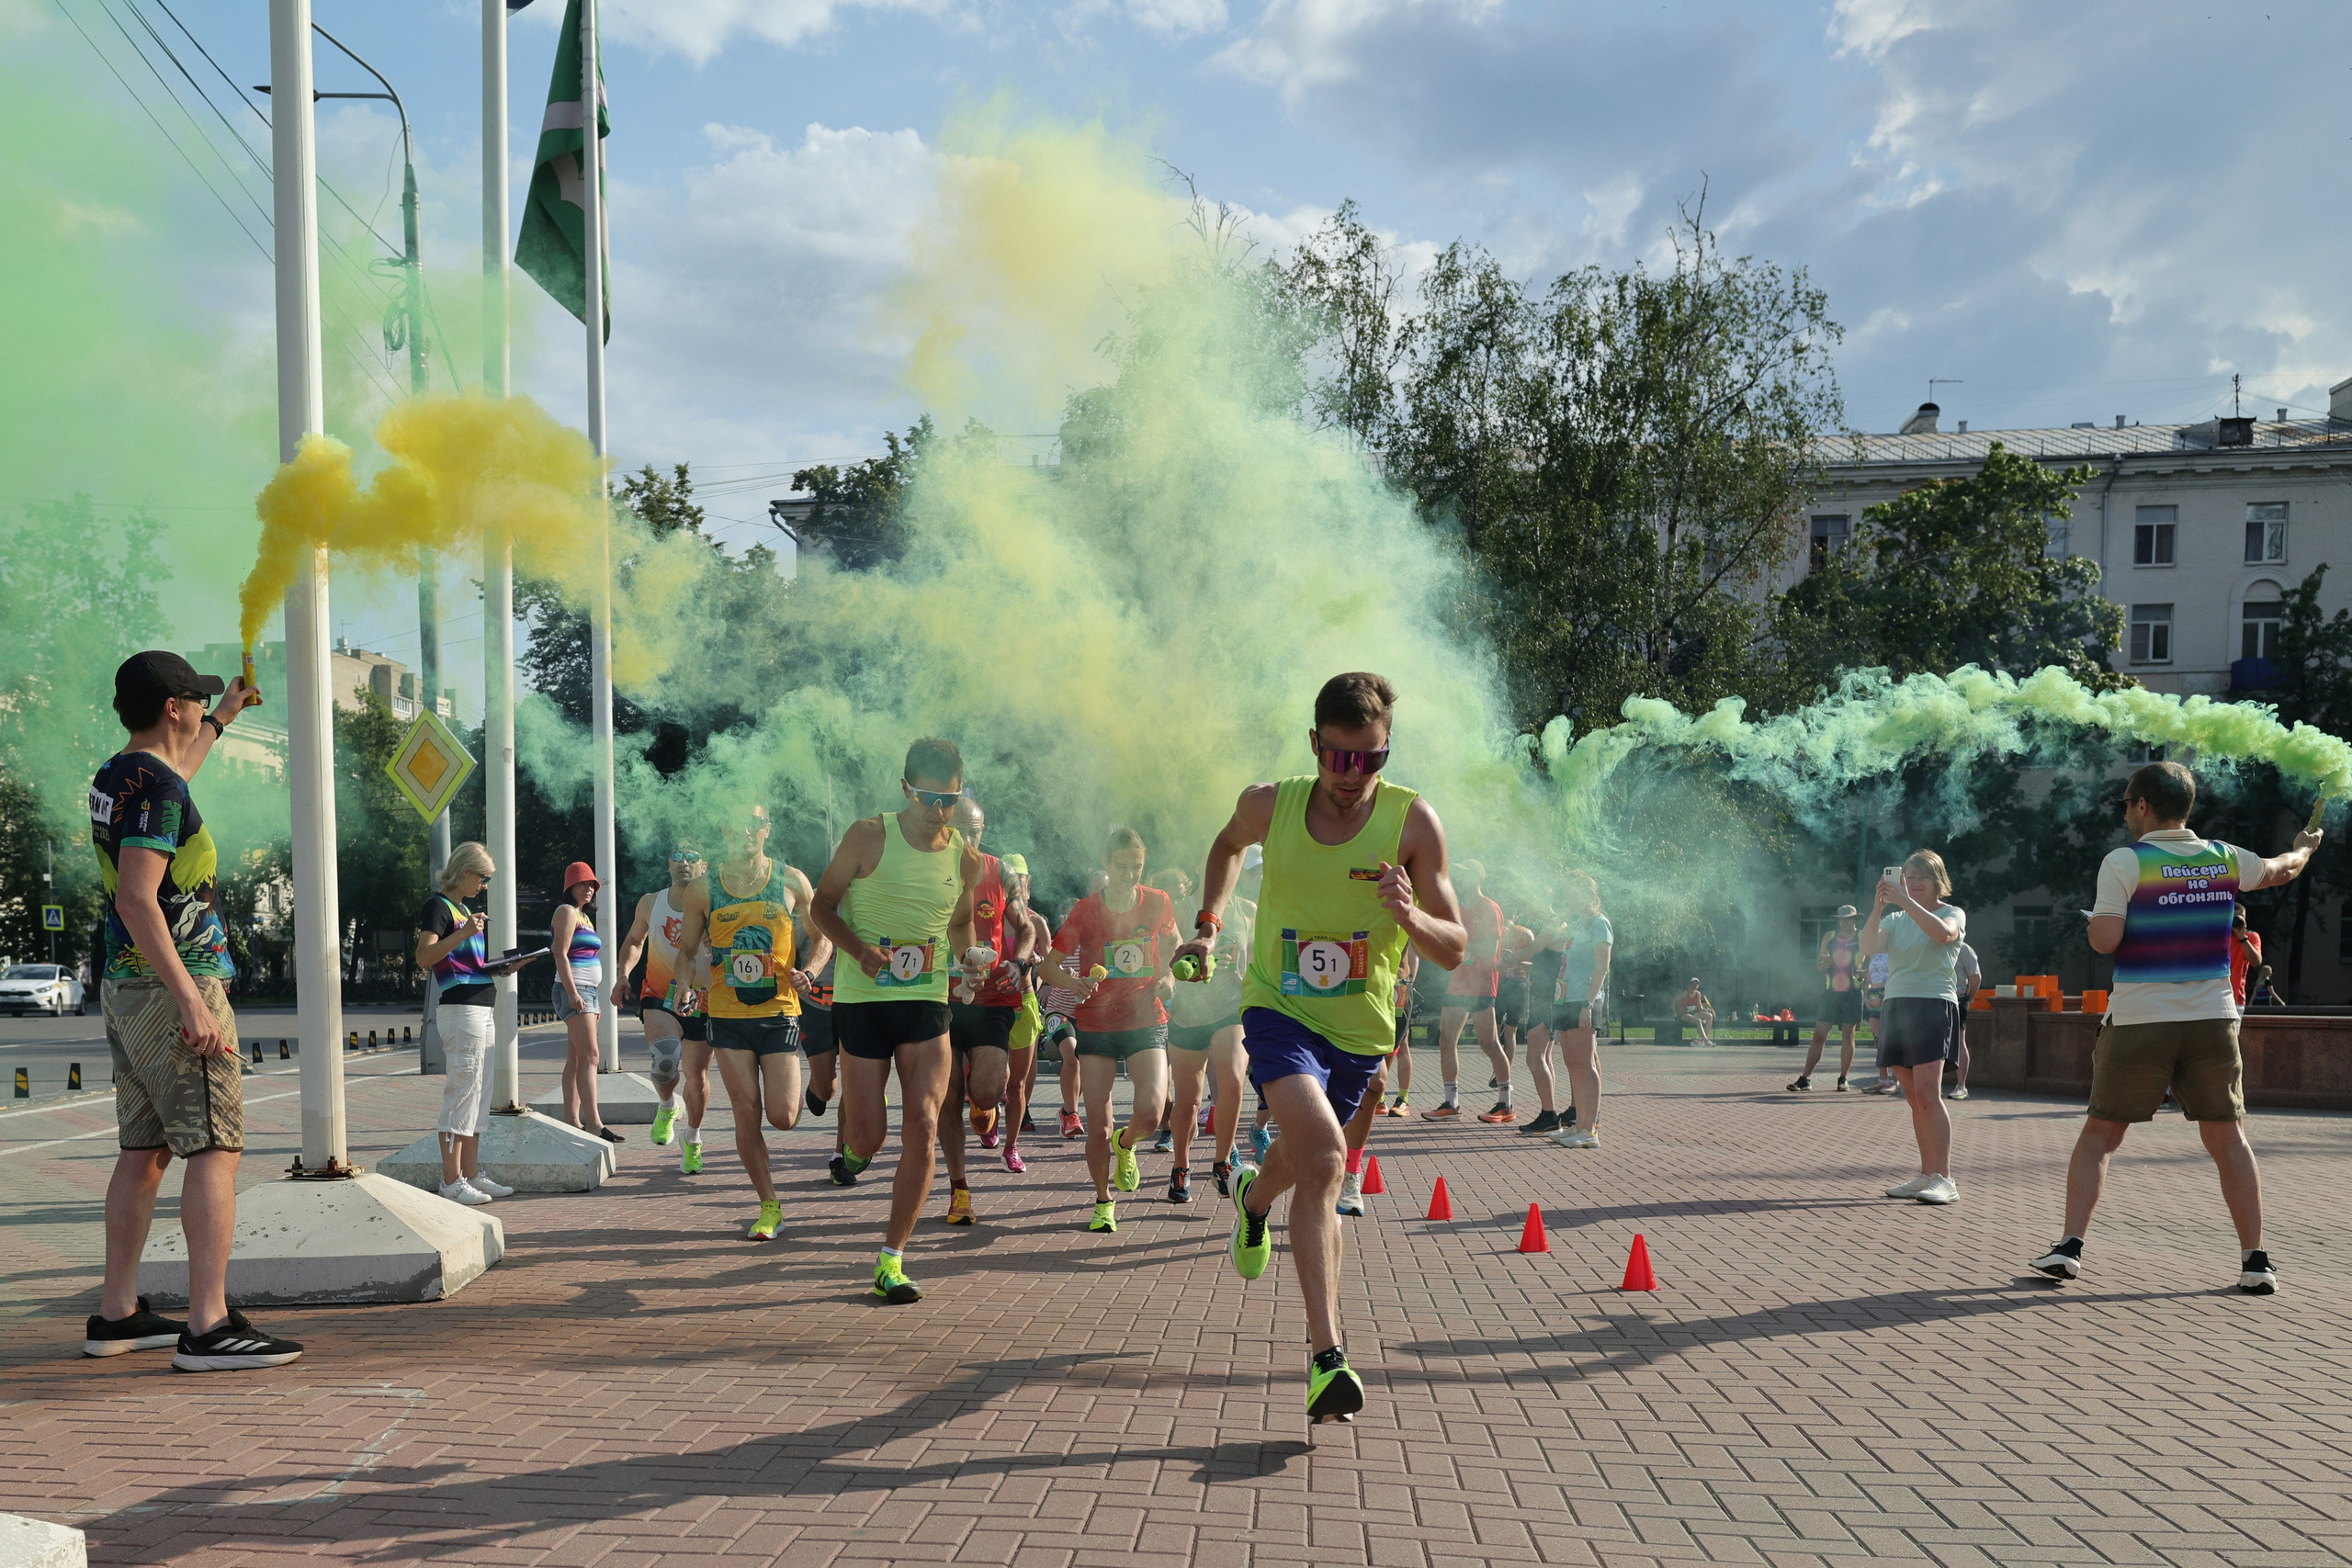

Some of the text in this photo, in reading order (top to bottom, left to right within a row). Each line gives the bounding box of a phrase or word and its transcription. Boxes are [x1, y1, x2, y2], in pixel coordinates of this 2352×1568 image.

[2161, 863, 2228, 879] Пейсера
[2187, 879, 2209, 889] не
[2158, 891, 2233, 905] обгонять
[901, 952, 910, 968] 7
[1122, 950, 1131, 964] 2
[1312, 949, 1326, 972] 5
[1330, 958, 1336, 972] 1
[738, 960, 752, 974] 16
